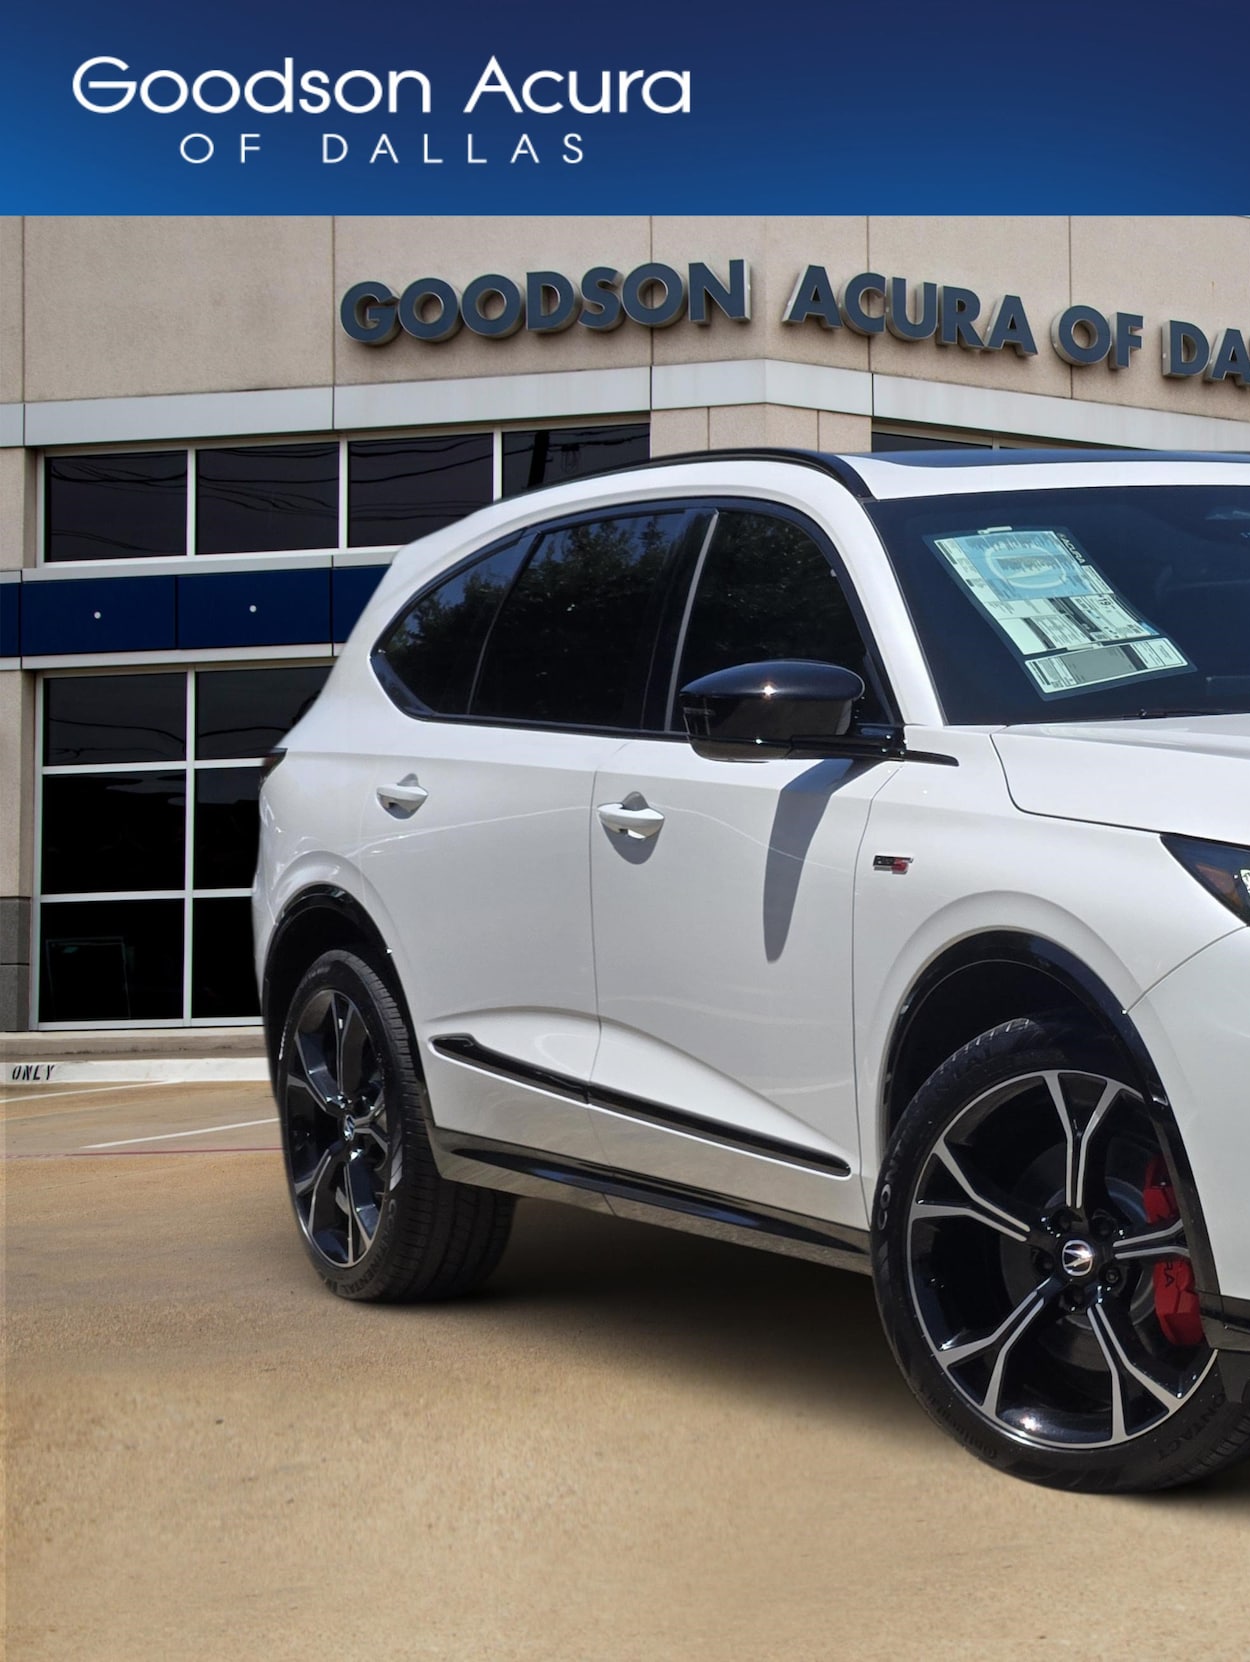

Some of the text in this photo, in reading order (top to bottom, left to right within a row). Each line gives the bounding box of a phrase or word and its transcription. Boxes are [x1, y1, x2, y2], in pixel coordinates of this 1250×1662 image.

[339, 258, 751, 346] GOODSON
[783, 263, 1038, 358] ACURA
[1049, 304, 1144, 371] OF
[11, 1064, 55, 1081] ONLY
